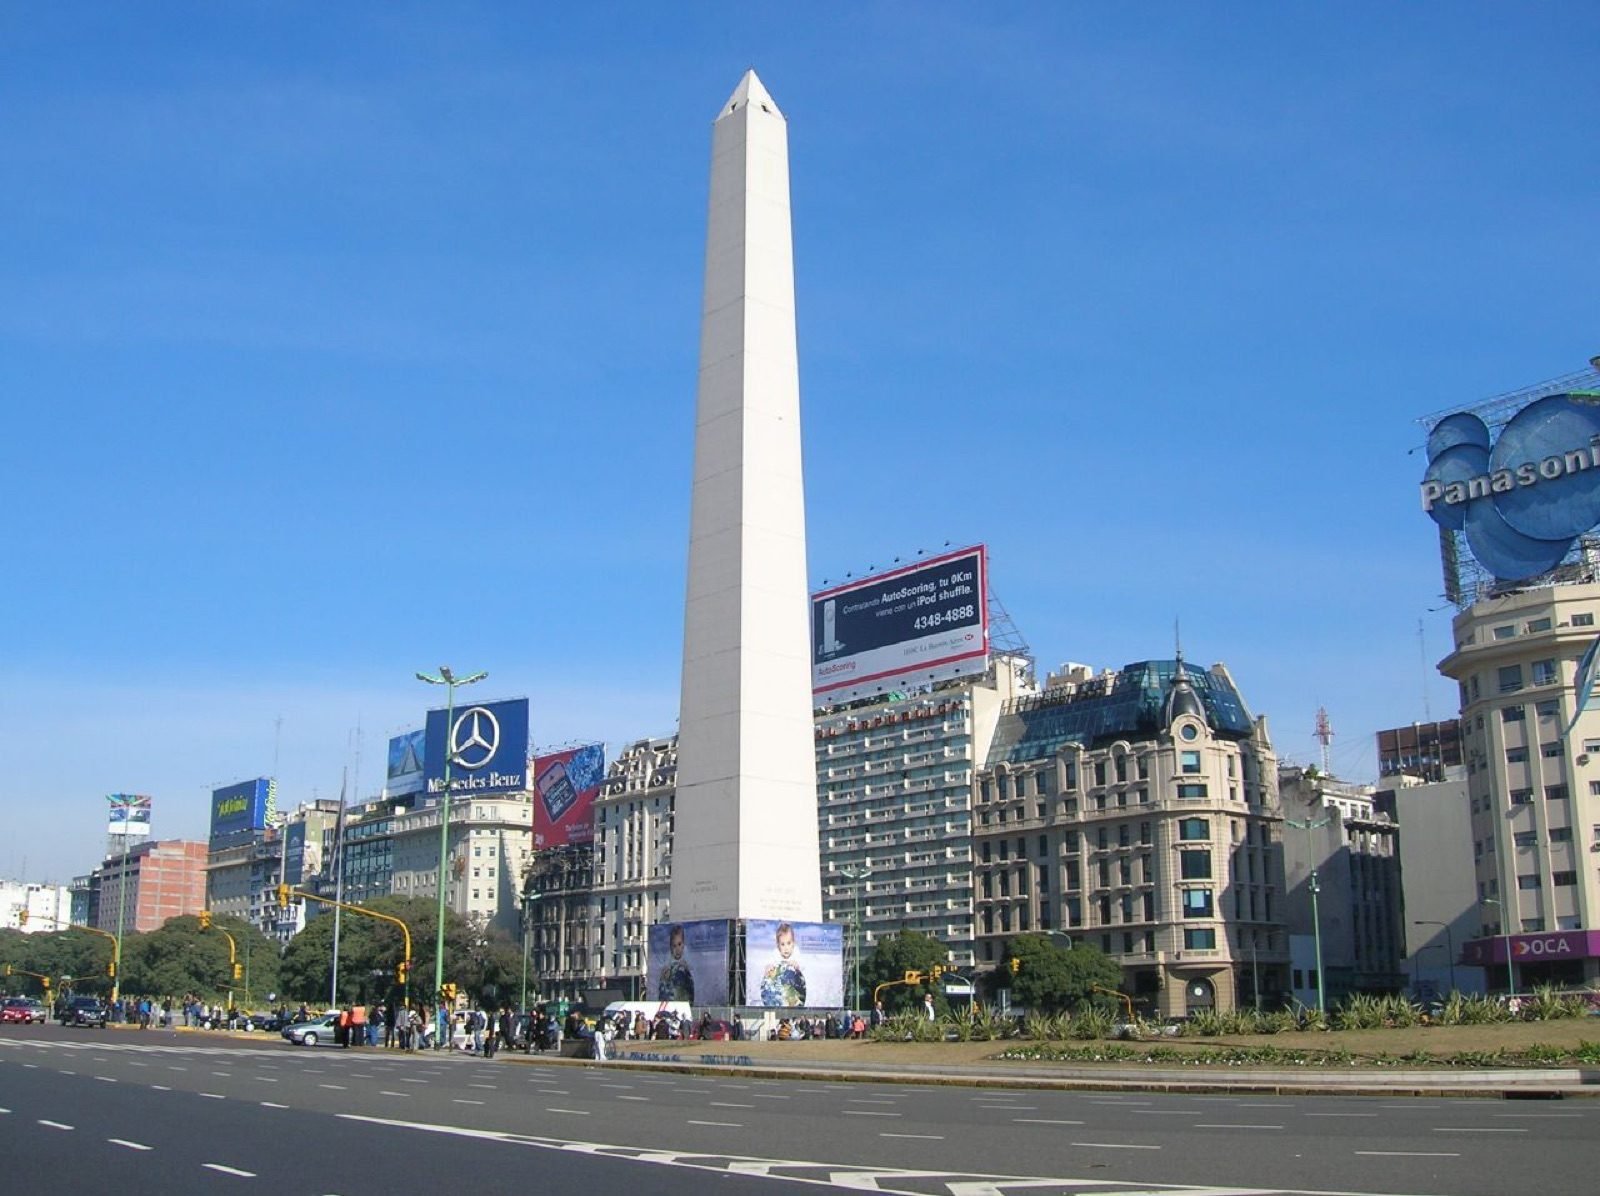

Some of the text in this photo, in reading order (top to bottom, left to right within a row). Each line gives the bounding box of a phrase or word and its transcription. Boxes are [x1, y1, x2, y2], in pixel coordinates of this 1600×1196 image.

[1421, 433, 1600, 512] Panasoni
[881, 581, 937, 604] AutoScoring,
[939, 578, 949, 587] tu
[917, 593, 937, 607] iPod
[938, 585, 973, 601] shuffle.
[914, 604, 975, 630] 4348-4888
[818, 660, 856, 676] AutoScoring
[1531, 938, 1571, 955] OCA
